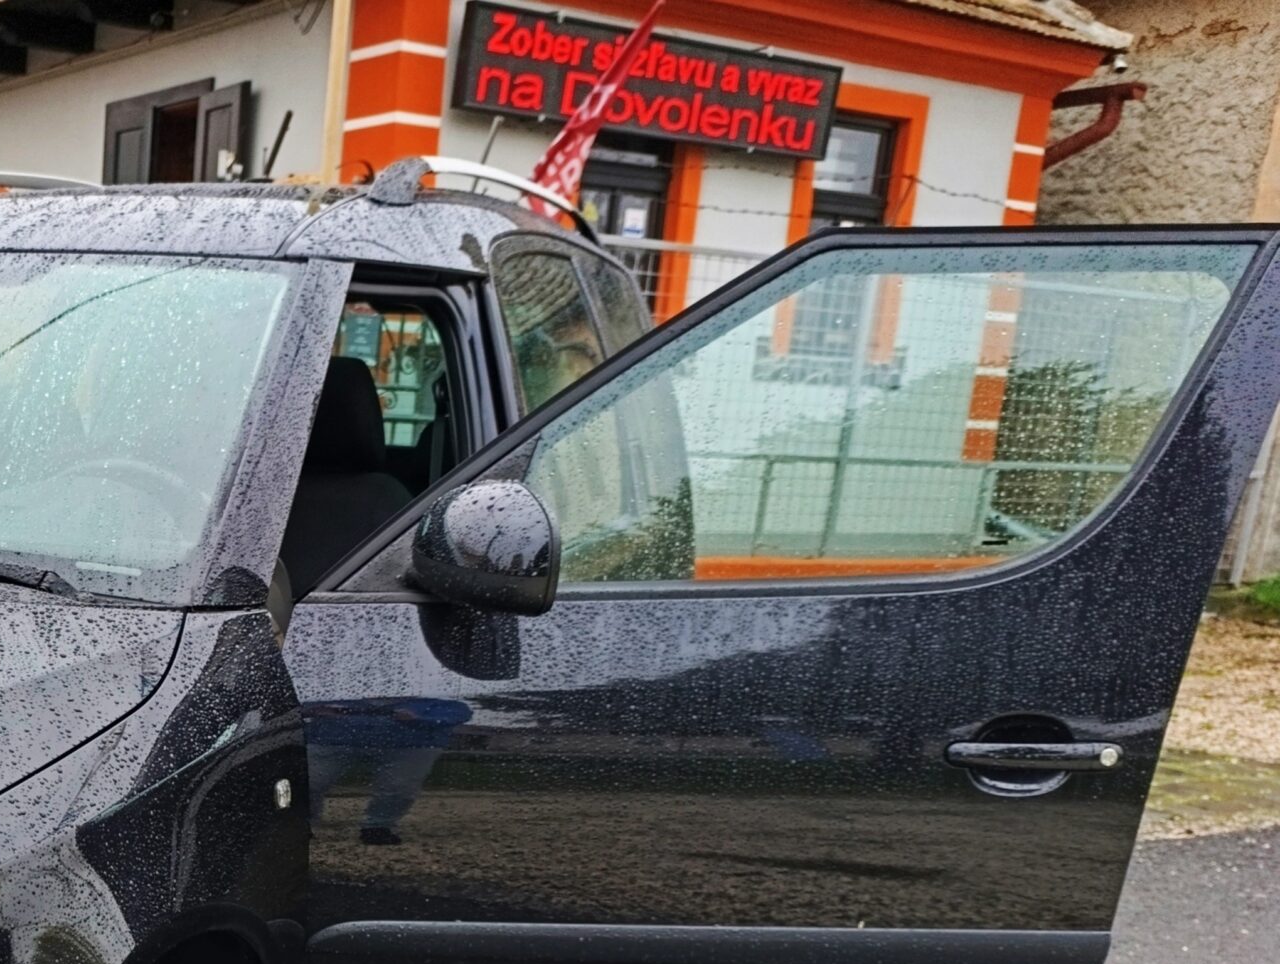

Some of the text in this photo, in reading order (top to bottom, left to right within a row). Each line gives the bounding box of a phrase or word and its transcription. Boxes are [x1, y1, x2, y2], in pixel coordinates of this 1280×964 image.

[487, 11, 589, 66] Zober
[720, 63, 741, 93] a
[747, 68, 824, 106] vyraz
[476, 66, 816, 151] na Dovolenku
